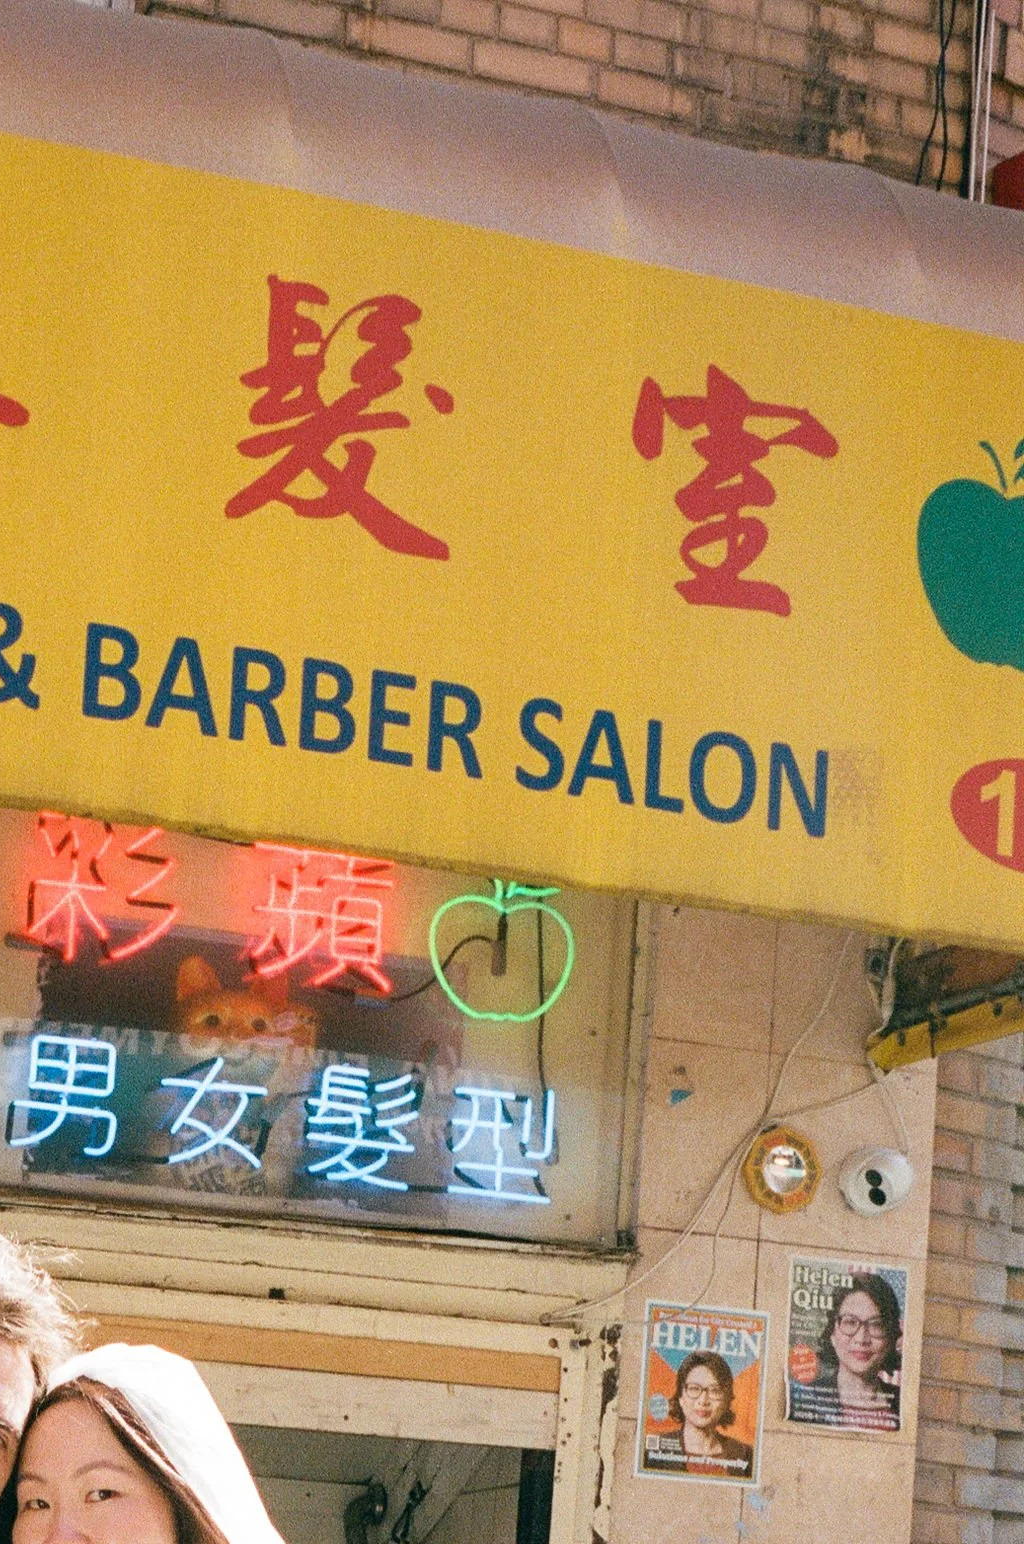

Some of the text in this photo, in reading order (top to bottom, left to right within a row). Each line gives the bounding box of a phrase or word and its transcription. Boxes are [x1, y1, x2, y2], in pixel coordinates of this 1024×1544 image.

[82, 622, 483, 779] BARBER
[516, 698, 830, 838] SALON
[7, 1034, 557, 1204] 男女髮型
[794, 1265, 854, 1289] Helen
[793, 1287, 834, 1311] Qiu
[651, 1321, 763, 1359] HELEN
